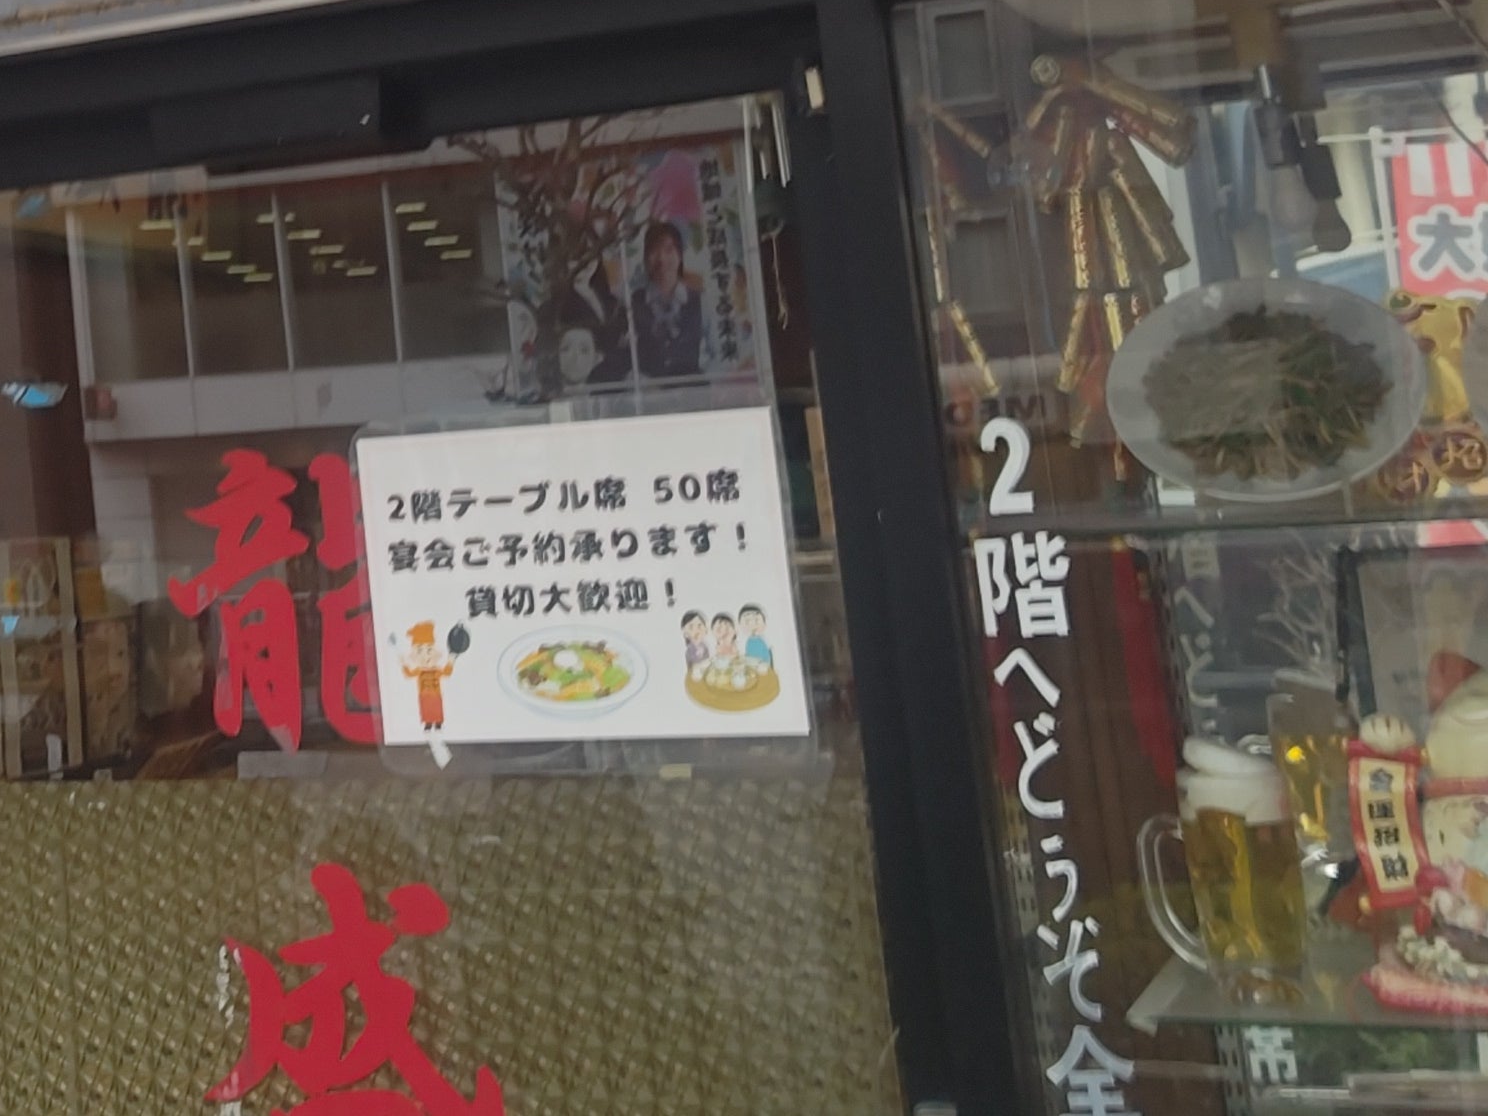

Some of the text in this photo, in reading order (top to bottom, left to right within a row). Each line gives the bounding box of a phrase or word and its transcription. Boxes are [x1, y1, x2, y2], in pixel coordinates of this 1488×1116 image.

[387, 467, 742, 522] 2階テーブル席 50席
[387, 521, 748, 575] 宴会ご予約承ります！
[465, 577, 677, 619] 貸切大歓迎！
